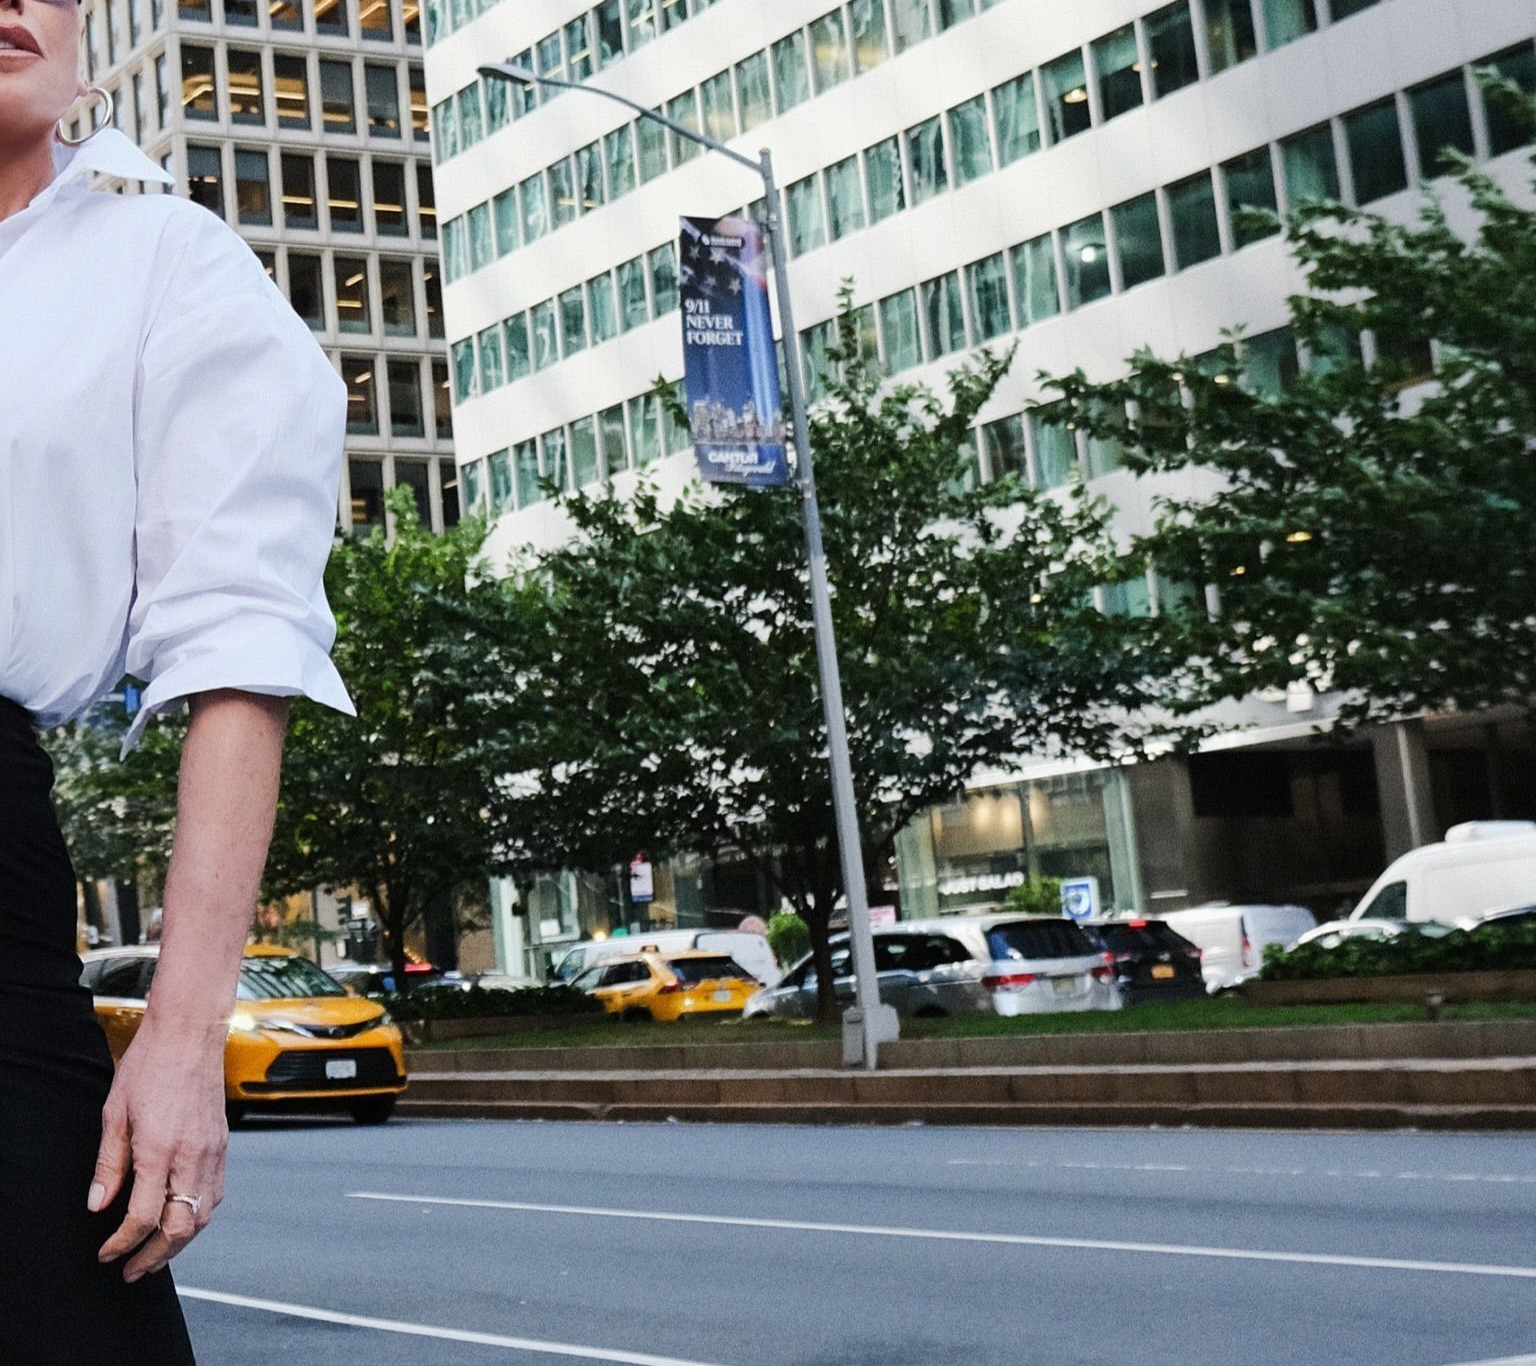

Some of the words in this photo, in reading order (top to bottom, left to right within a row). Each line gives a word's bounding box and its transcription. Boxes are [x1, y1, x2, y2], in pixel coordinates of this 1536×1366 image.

[684, 298, 710, 314] 9/11
[686, 315, 734, 330] NEVER
[687, 330, 744, 346] FORGET
